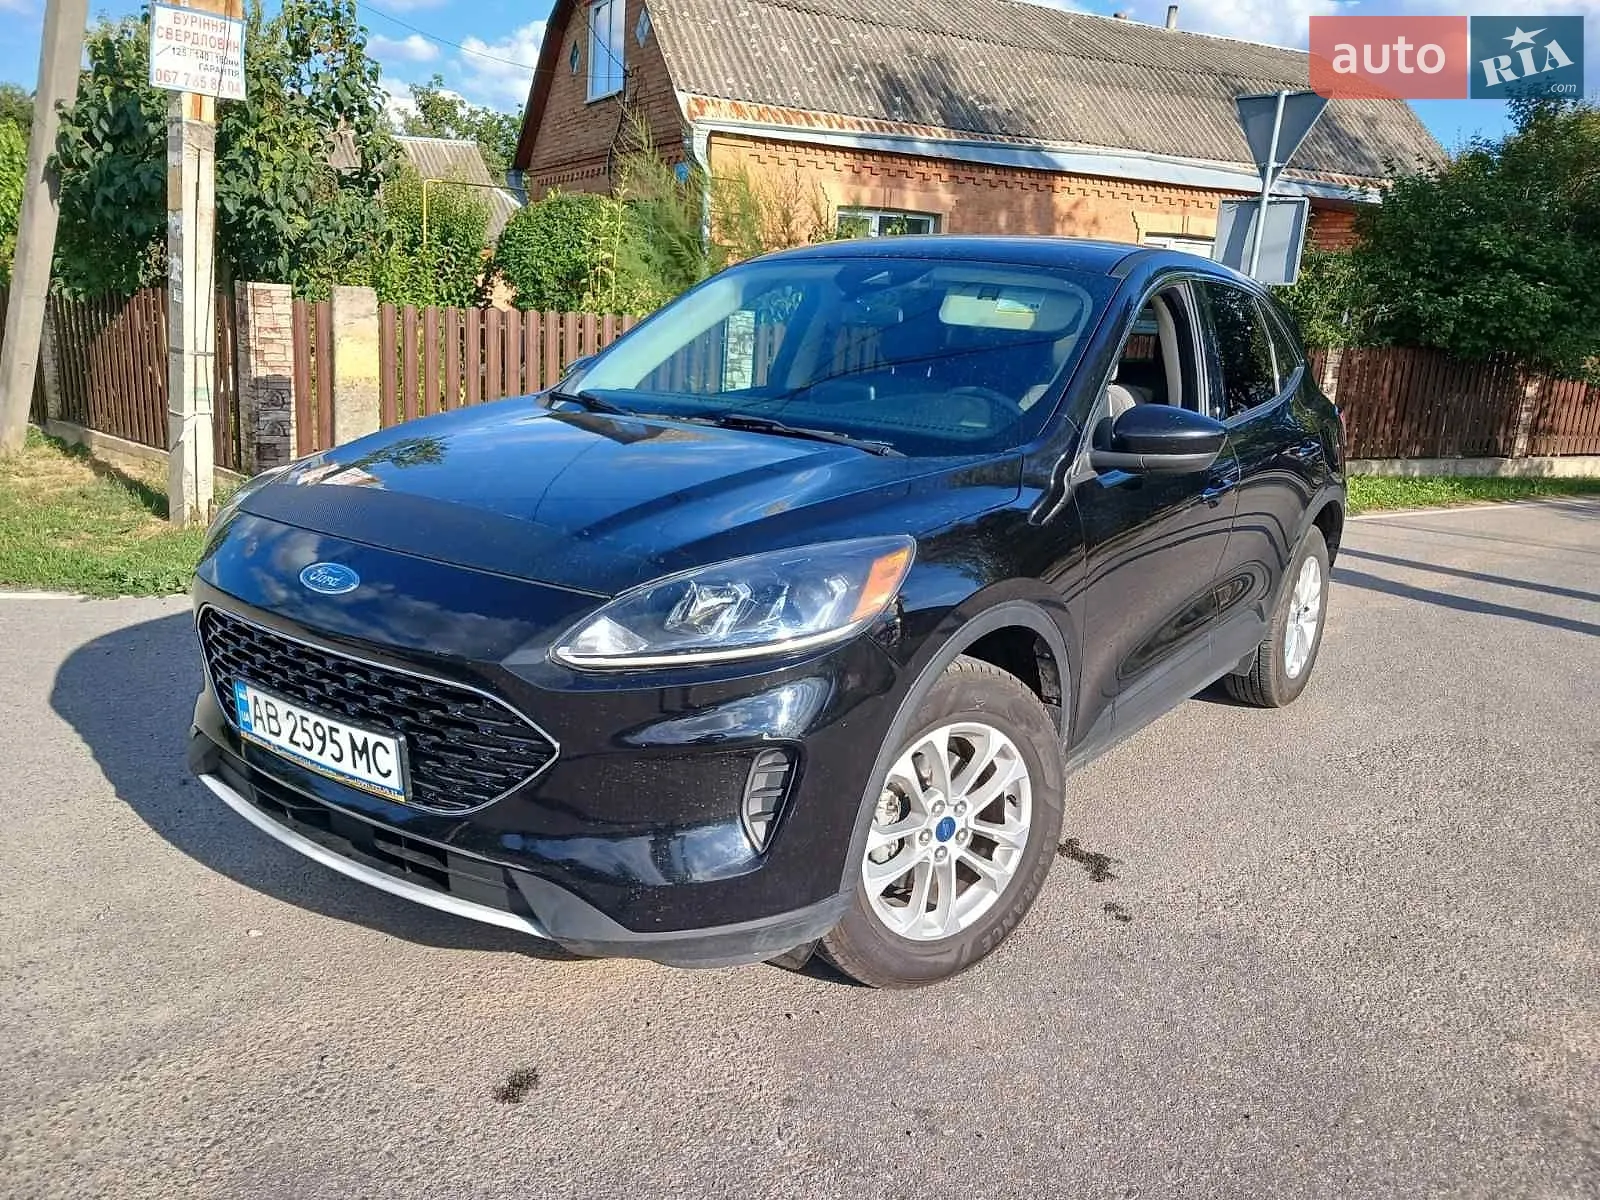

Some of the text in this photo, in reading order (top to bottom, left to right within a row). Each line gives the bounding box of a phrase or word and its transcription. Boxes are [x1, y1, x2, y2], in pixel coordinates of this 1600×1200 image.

[172, 11, 227, 32] БУРІННЯ
[156, 25, 240, 53] СВЕРДЛОВИН
[308, 567, 346, 588] Ford
[252, 695, 282, 737] AB
[286, 710, 344, 763] 2595
[348, 731, 392, 778] MC
